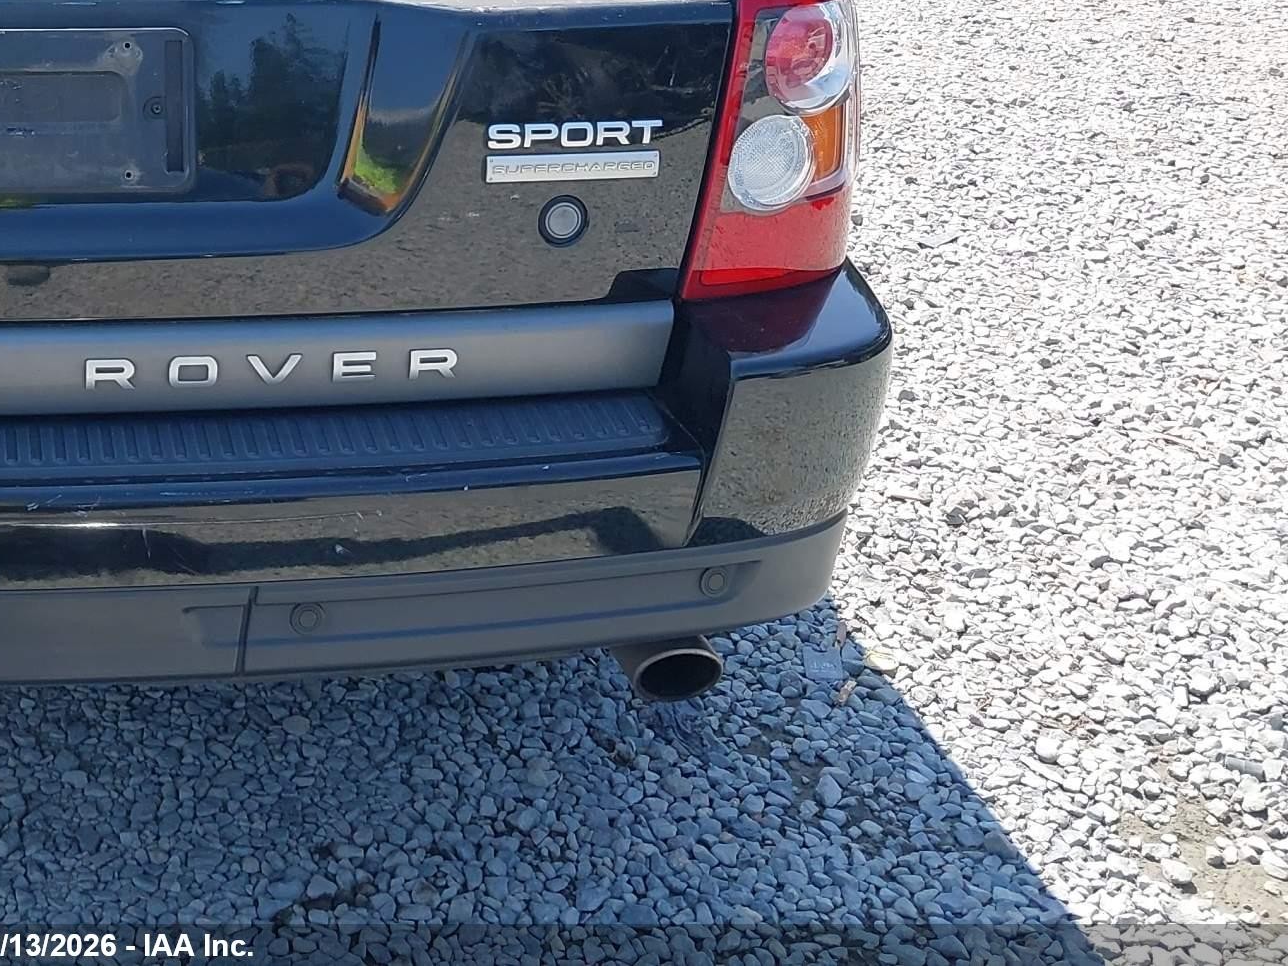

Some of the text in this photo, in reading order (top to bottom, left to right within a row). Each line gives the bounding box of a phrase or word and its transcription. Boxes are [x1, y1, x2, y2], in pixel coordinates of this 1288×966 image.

[487, 119, 664, 150] SPORT
[491, 160, 656, 177] SUPERCHARGED
[85, 347, 459, 391] ROVER
